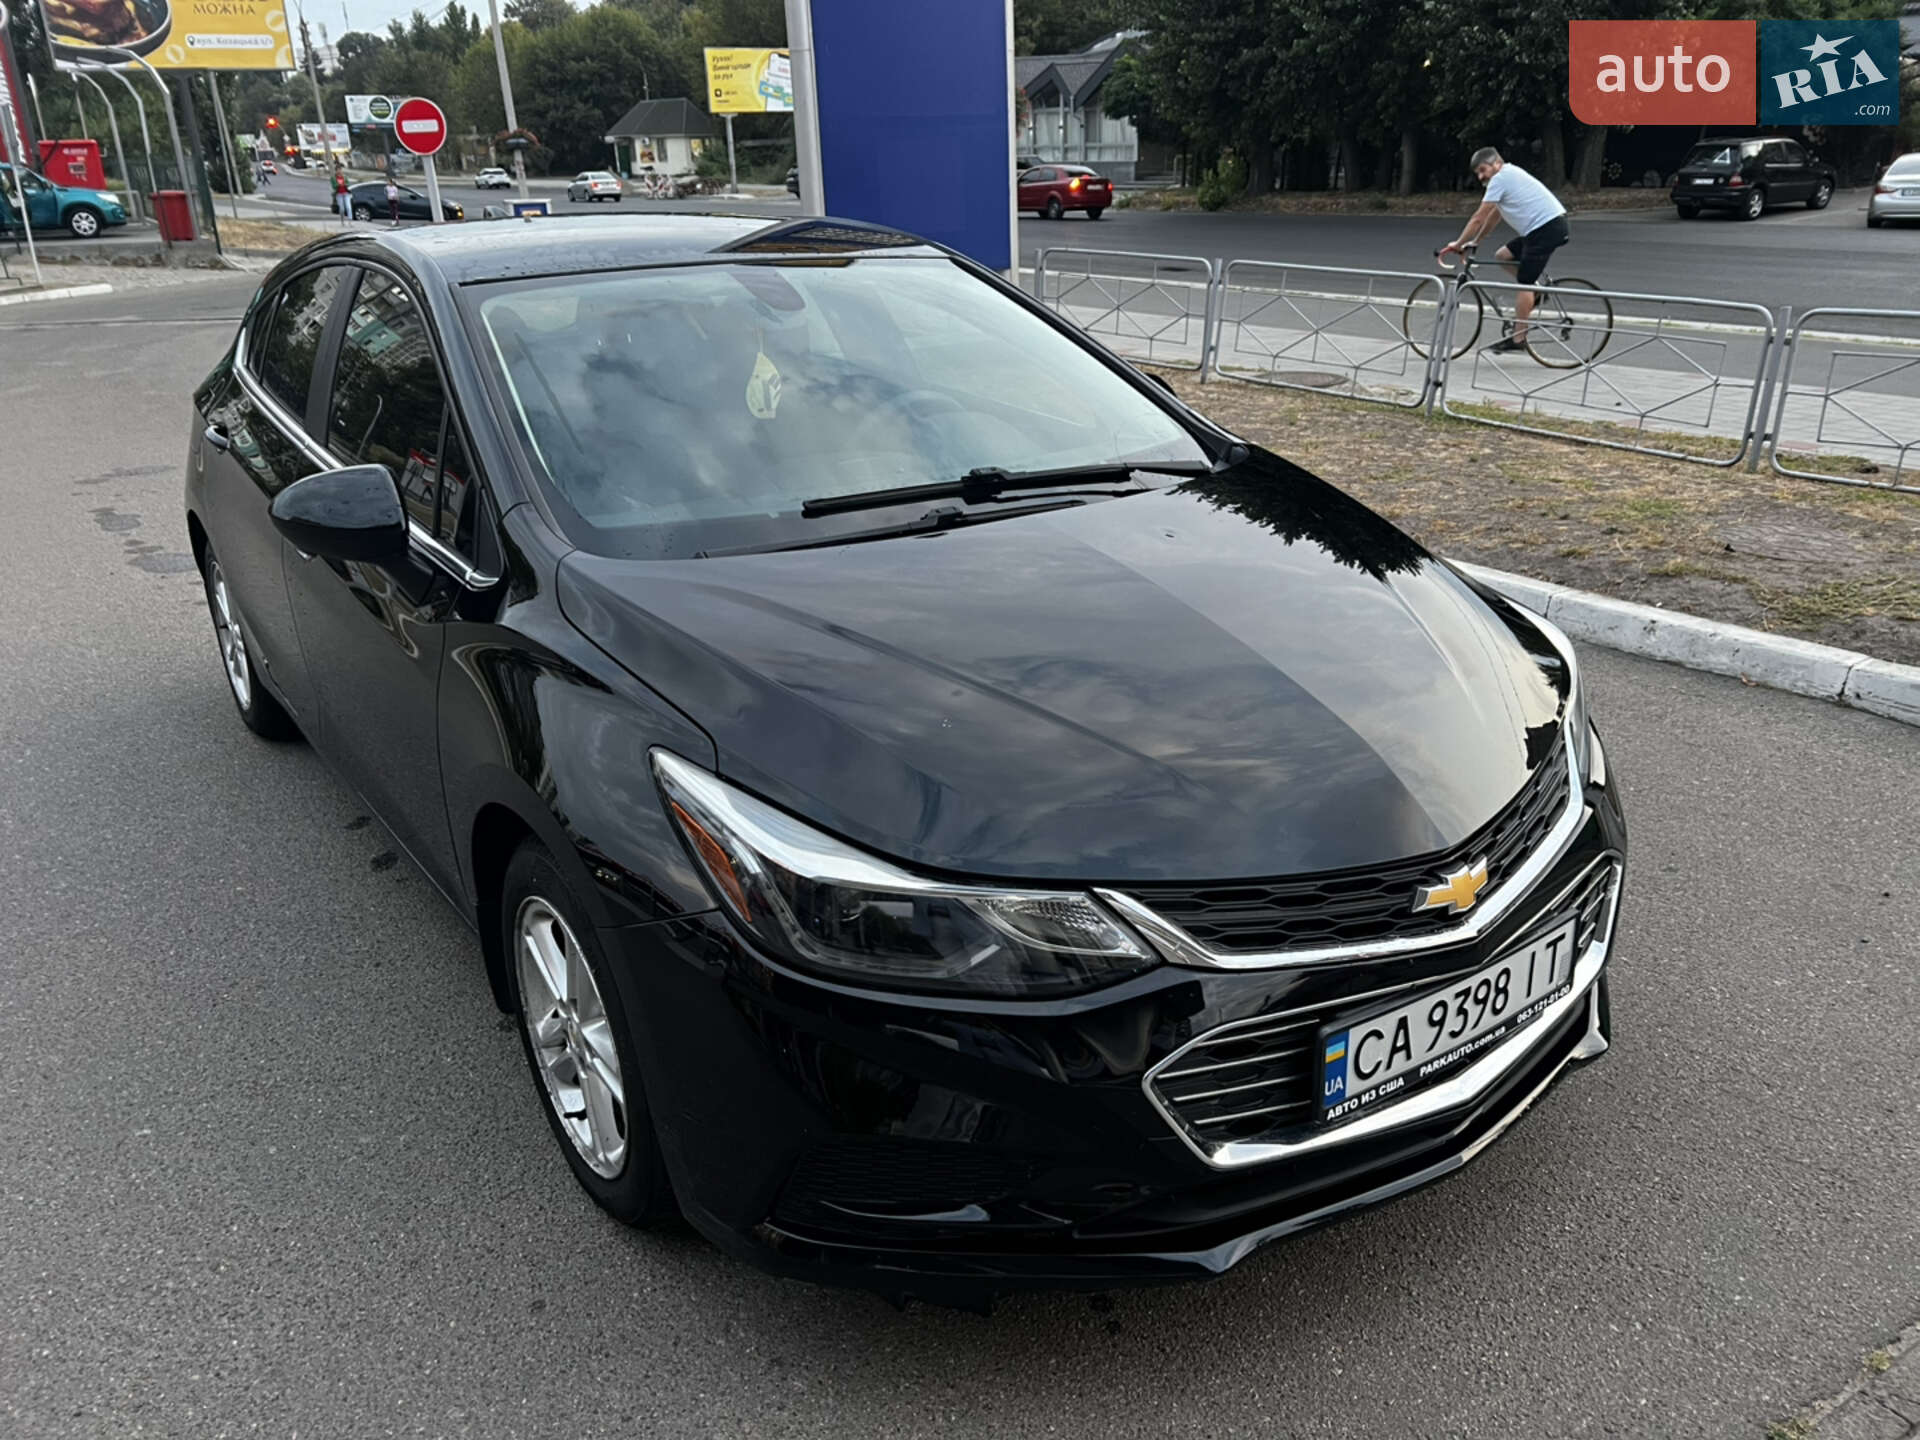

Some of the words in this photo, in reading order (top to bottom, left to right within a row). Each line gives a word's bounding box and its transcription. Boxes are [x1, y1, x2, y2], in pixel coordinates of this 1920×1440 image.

[193, 3, 256, 16] МОЖНА
[1354, 1015, 1412, 1081] CA
[1426, 967, 1511, 1053] 9398
[1419, 1025, 1507, 1077] PARKAUTO.com.ua
[1324, 1076, 1344, 1097] UA
[1327, 1097, 1359, 1121] АВТО
[1361, 1089, 1377, 1105] ИЗ
[1378, 1076, 1405, 1096] США
